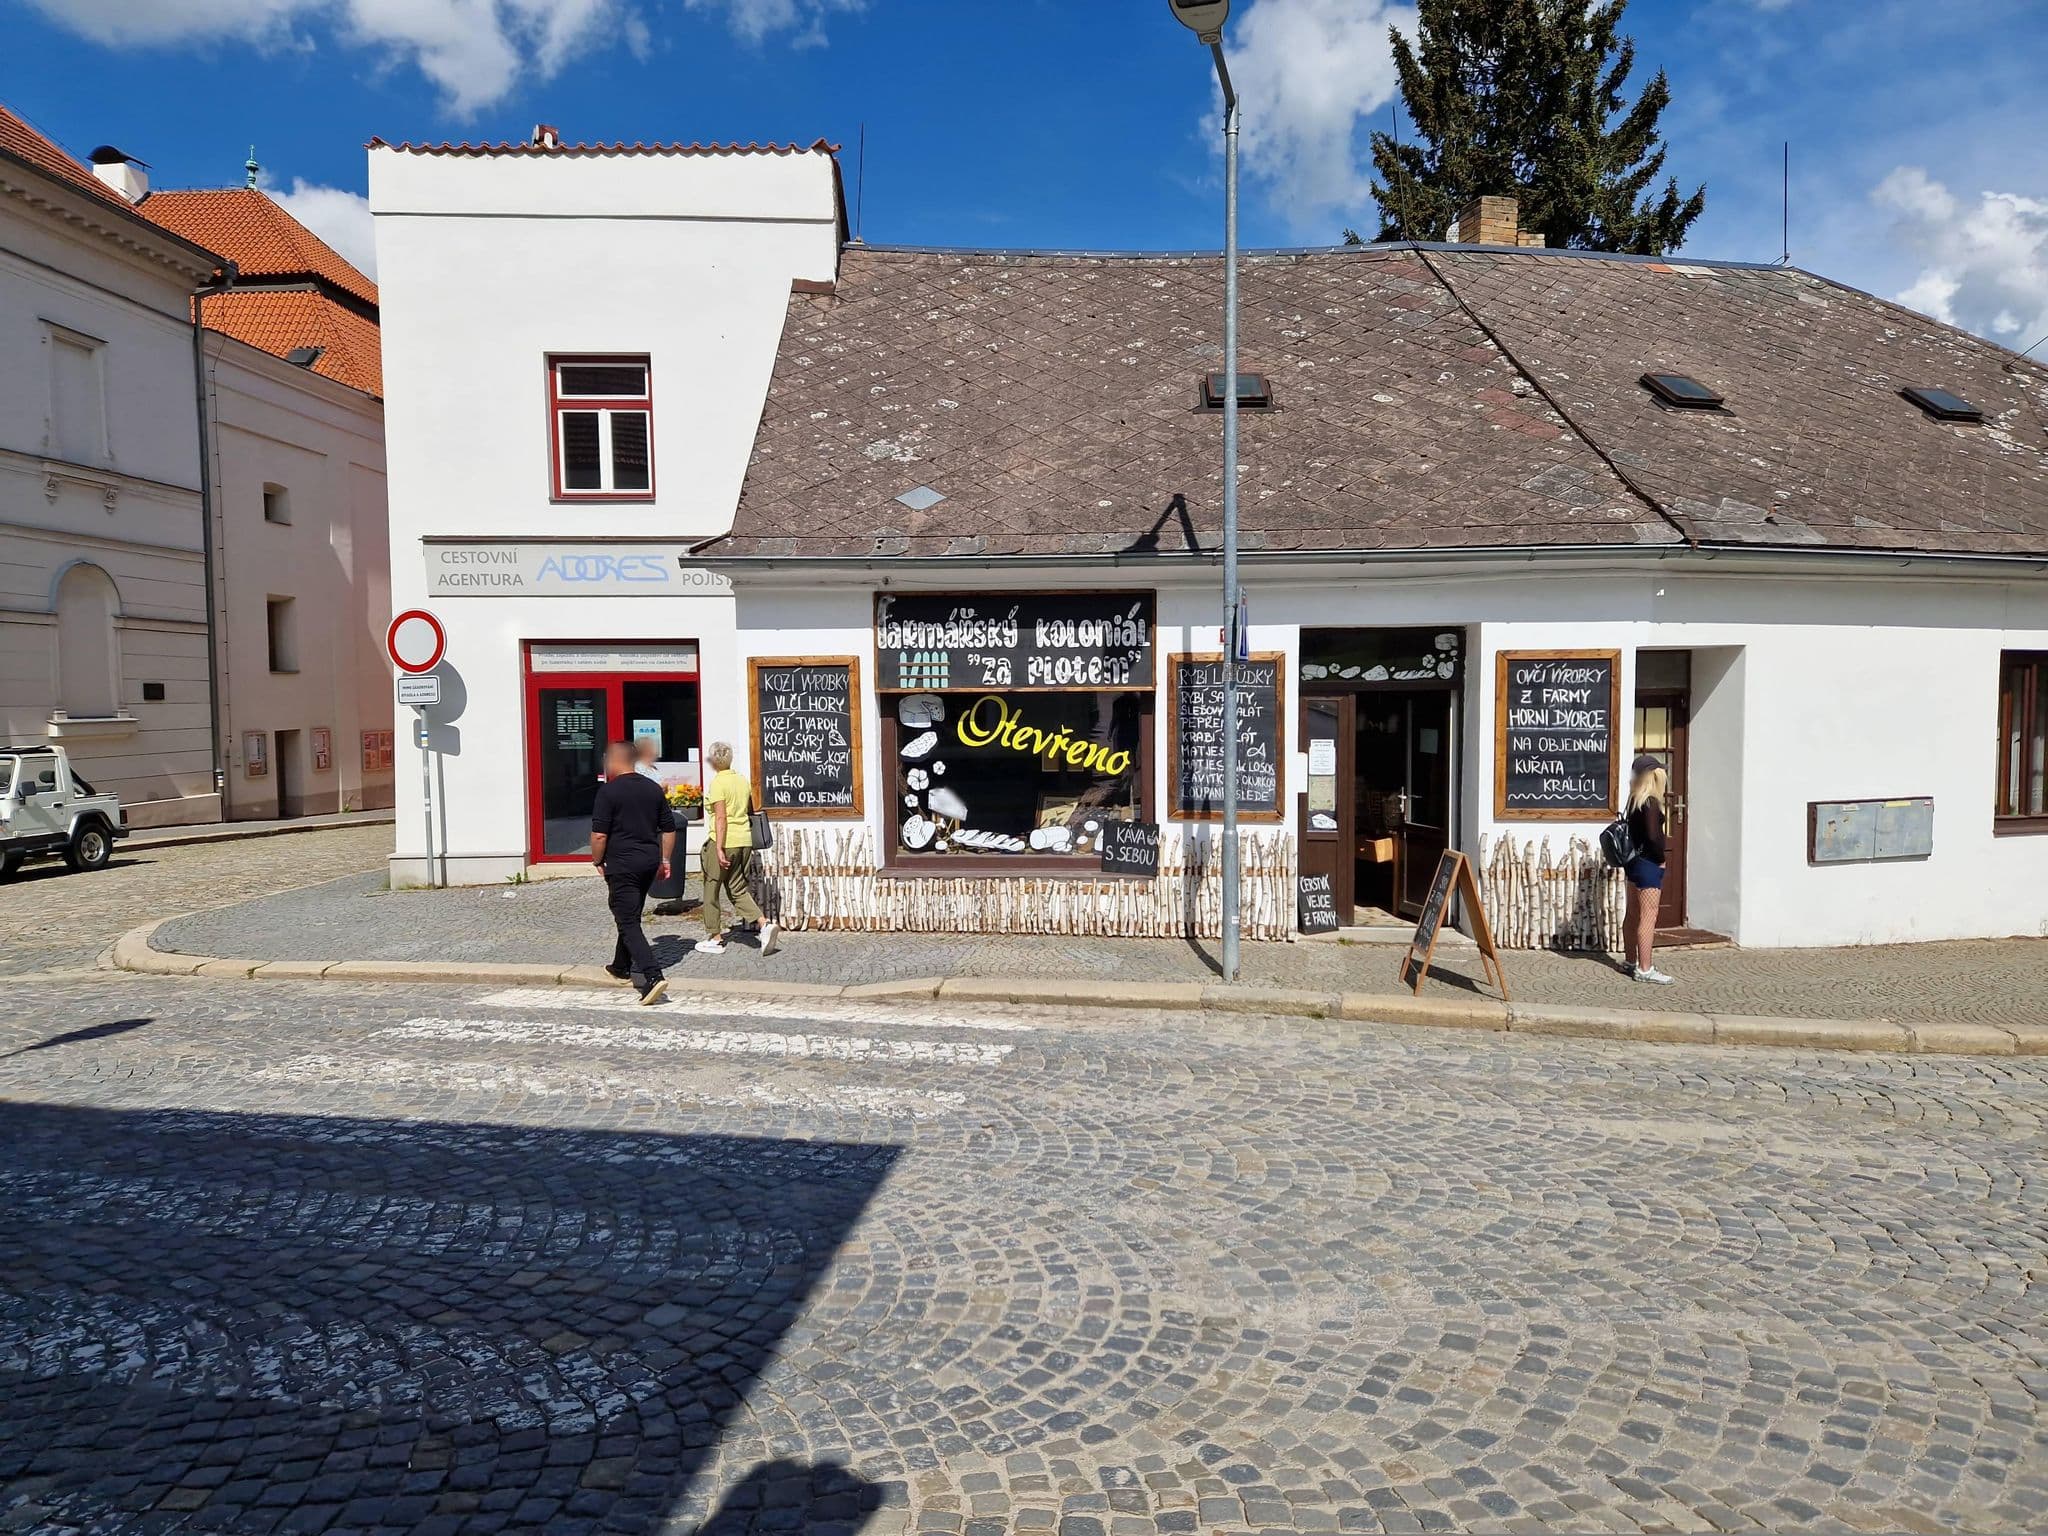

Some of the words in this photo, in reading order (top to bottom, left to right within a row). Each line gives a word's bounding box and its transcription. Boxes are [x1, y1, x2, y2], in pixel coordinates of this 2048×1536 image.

[440, 547, 518, 564] CESTOVNÍ
[536, 555, 669, 582] ADORES
[438, 573, 523, 586] AGENTURA
[764, 667, 802, 692] KOZÍ
[801, 669, 849, 692] VÝROBKY
[1178, 663, 1214, 685] RYBÍ
[1213, 664, 1274, 685] LŮDKY
[1516, 663, 1555, 686] OVČÍ
[1551, 663, 1607, 685] VÝROBKY
[775, 692, 807, 711] VLČÍ
[808, 695, 845, 712] HORY
[1181, 687, 1209, 704] RYBÍ
[1520, 689, 1533, 704] Z
[1542, 688, 1592, 705] FARMY
[1236, 702, 1264, 718] ALÁT
[1552, 709, 1607, 729] DVORCE
[763, 712, 796, 730] KOZÍ
[796, 716, 838, 731] TVAROH
[764, 729, 795, 746] KOZÍ
[793, 729, 825, 749] SÝRY
[957, 695, 1131, 776] Otevřeno
[1181, 729, 1223, 743] KRABÍ
[1513, 736, 1532, 752] NA
[1538, 732, 1608, 753] OBJEDNÁNÍ
[763, 746, 823, 764] NAKLÁDANÉ
[827, 748, 850, 765] KOZÍ
[1181, 745, 1225, 757] MATJES
[814, 760, 841, 779] SÝRY
[1515, 755, 1564, 775] KUŘATA
[766, 770, 805, 788] MLÉKO
[1182, 771, 1225, 785] ZÁVITK
[1543, 773, 1596, 793] KRÁLÍCI
[774, 791, 791, 803] NA
[798, 786, 853, 804] OBJEDNÁNÍ
[1116, 824, 1146, 845] KÁVA
[1105, 845, 1114, 861] S
[1116, 846, 1155, 866] SEBOU
[1306, 894, 1331, 908] VEJCE
[1303, 912, 1312, 927] Z
[1312, 911, 1338, 927] FARMY
